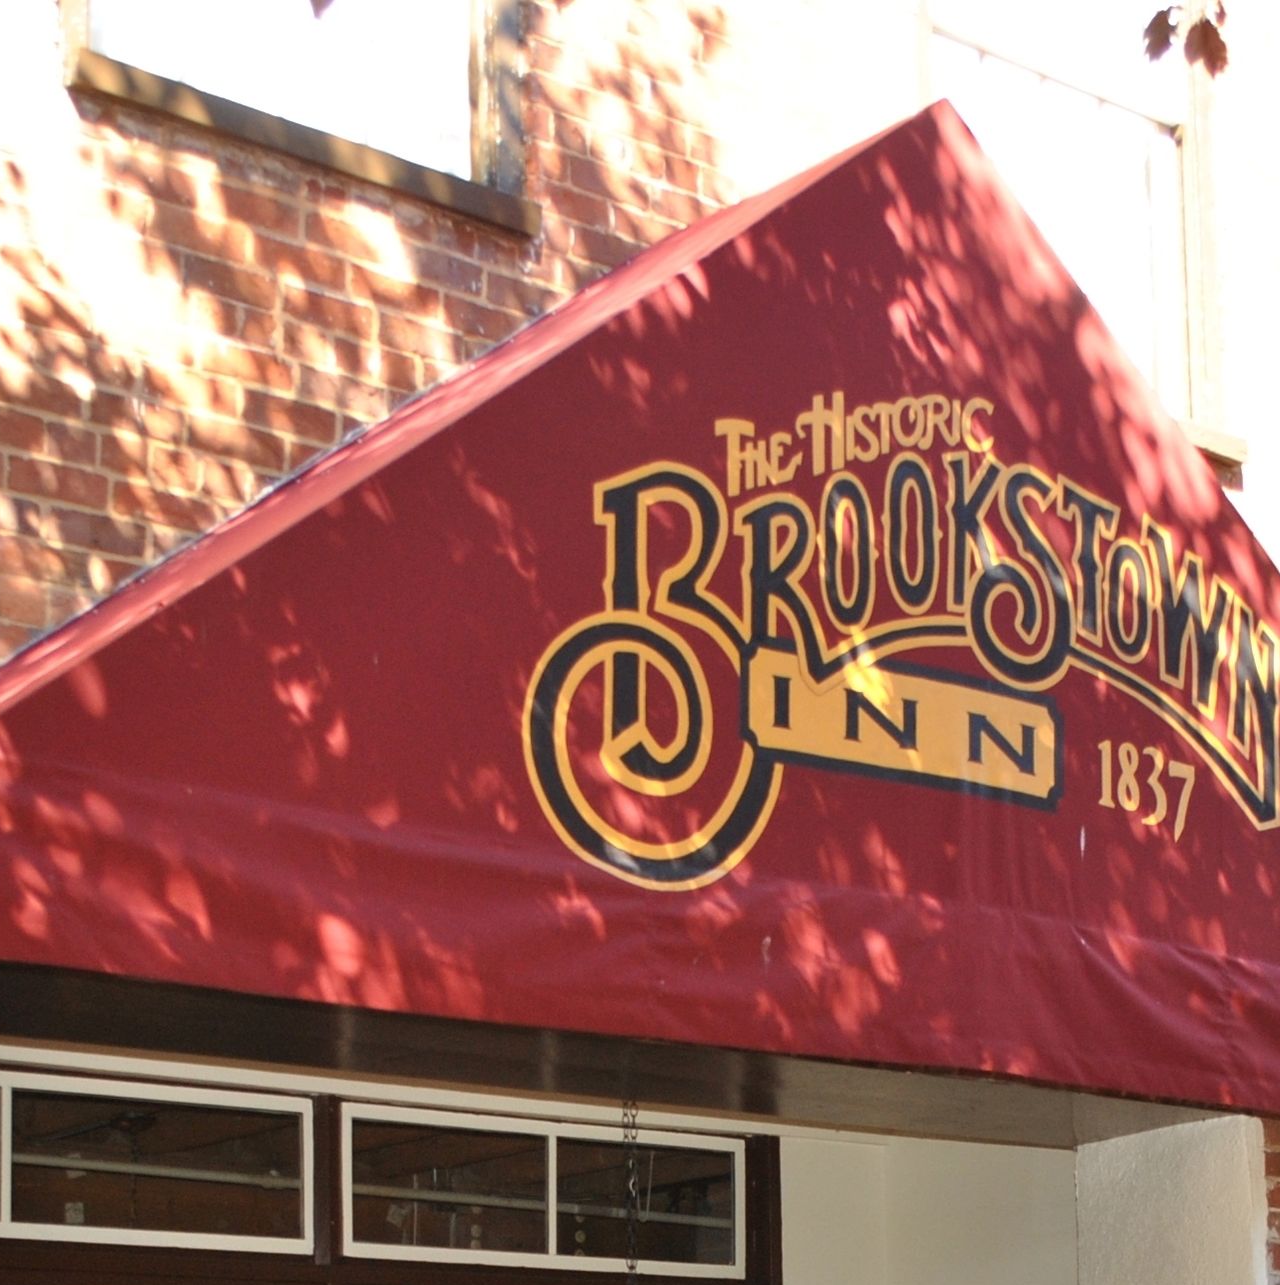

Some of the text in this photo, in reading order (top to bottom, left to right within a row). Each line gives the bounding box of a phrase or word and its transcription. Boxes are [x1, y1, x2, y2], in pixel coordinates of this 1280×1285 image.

[714, 390, 995, 497] THE HISTORIC
[773, 674, 1036, 776] INN
[1097, 740, 1196, 842] 1837
